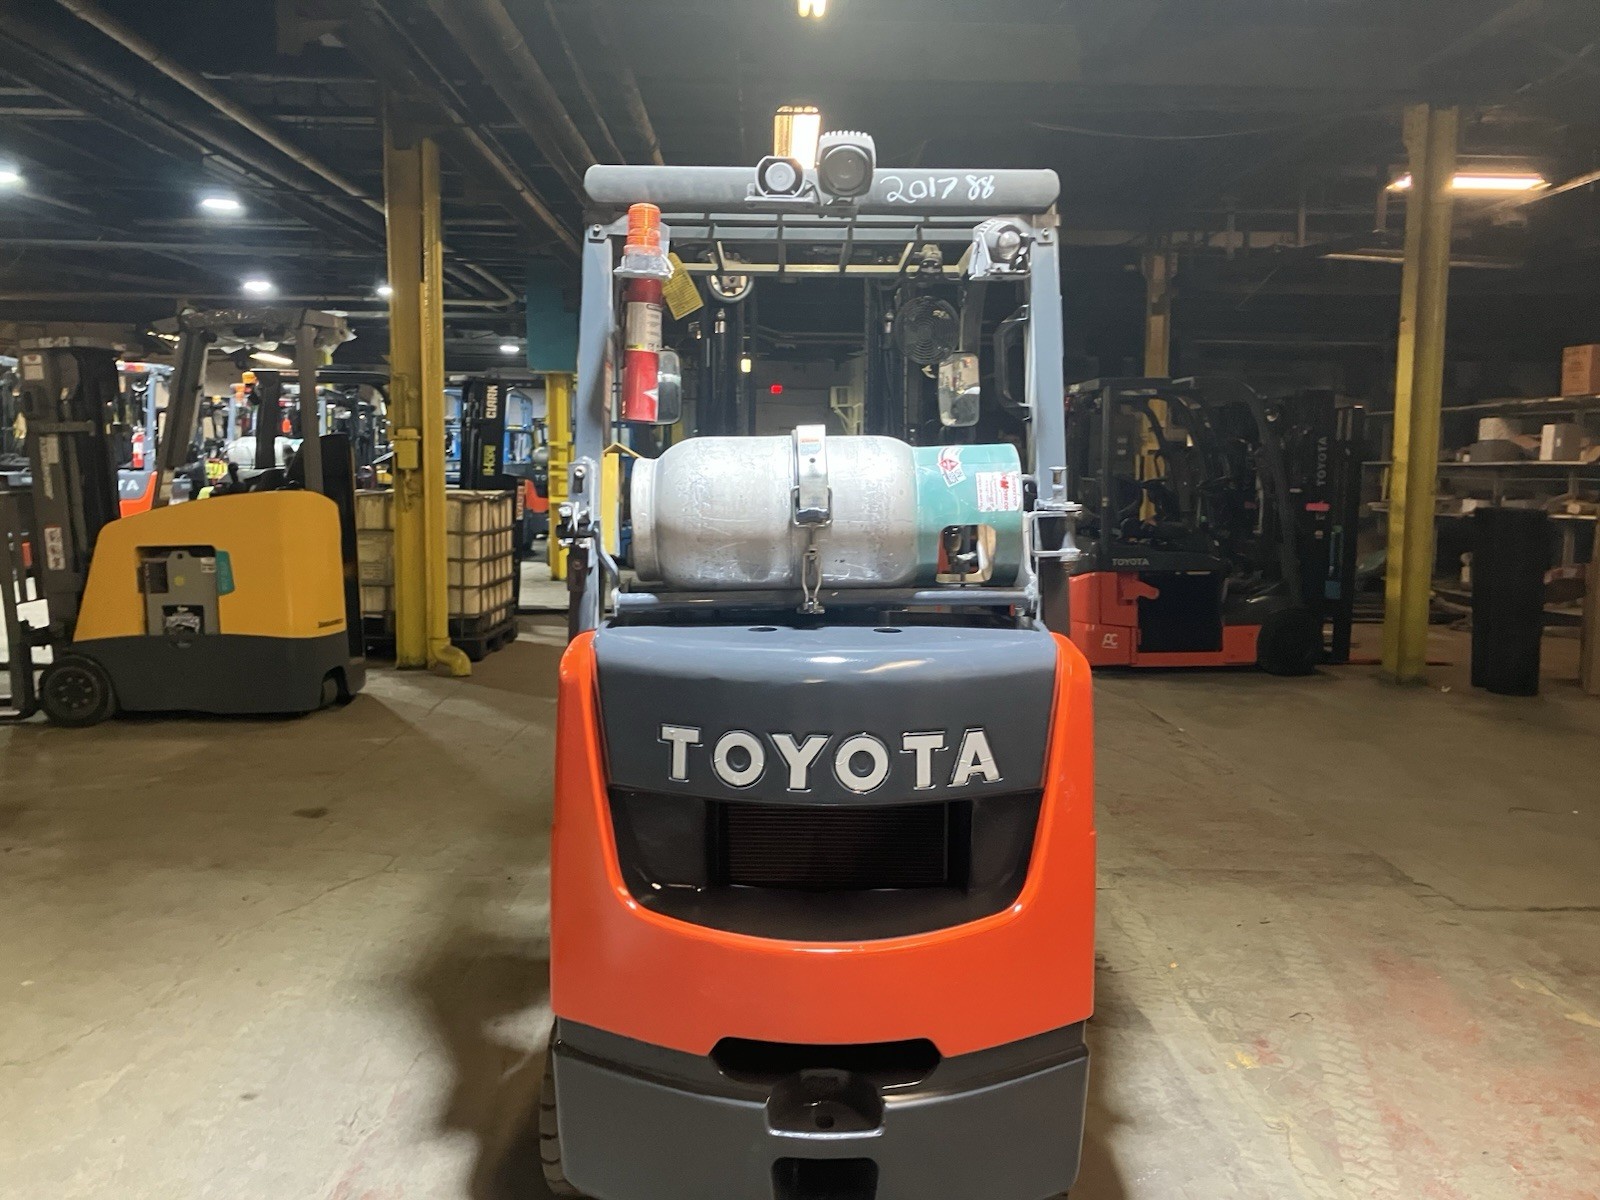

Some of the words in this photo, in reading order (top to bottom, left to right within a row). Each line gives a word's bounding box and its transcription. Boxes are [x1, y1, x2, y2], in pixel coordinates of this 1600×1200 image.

[880, 176, 958, 203] 2017
[965, 175, 995, 201] 88
[486, 385, 498, 419] CLARK
[1317, 436, 1328, 487] TOYOTA
[1112, 558, 1150, 566] TOYOTA
[657, 723, 1003, 796] TOYOTA
